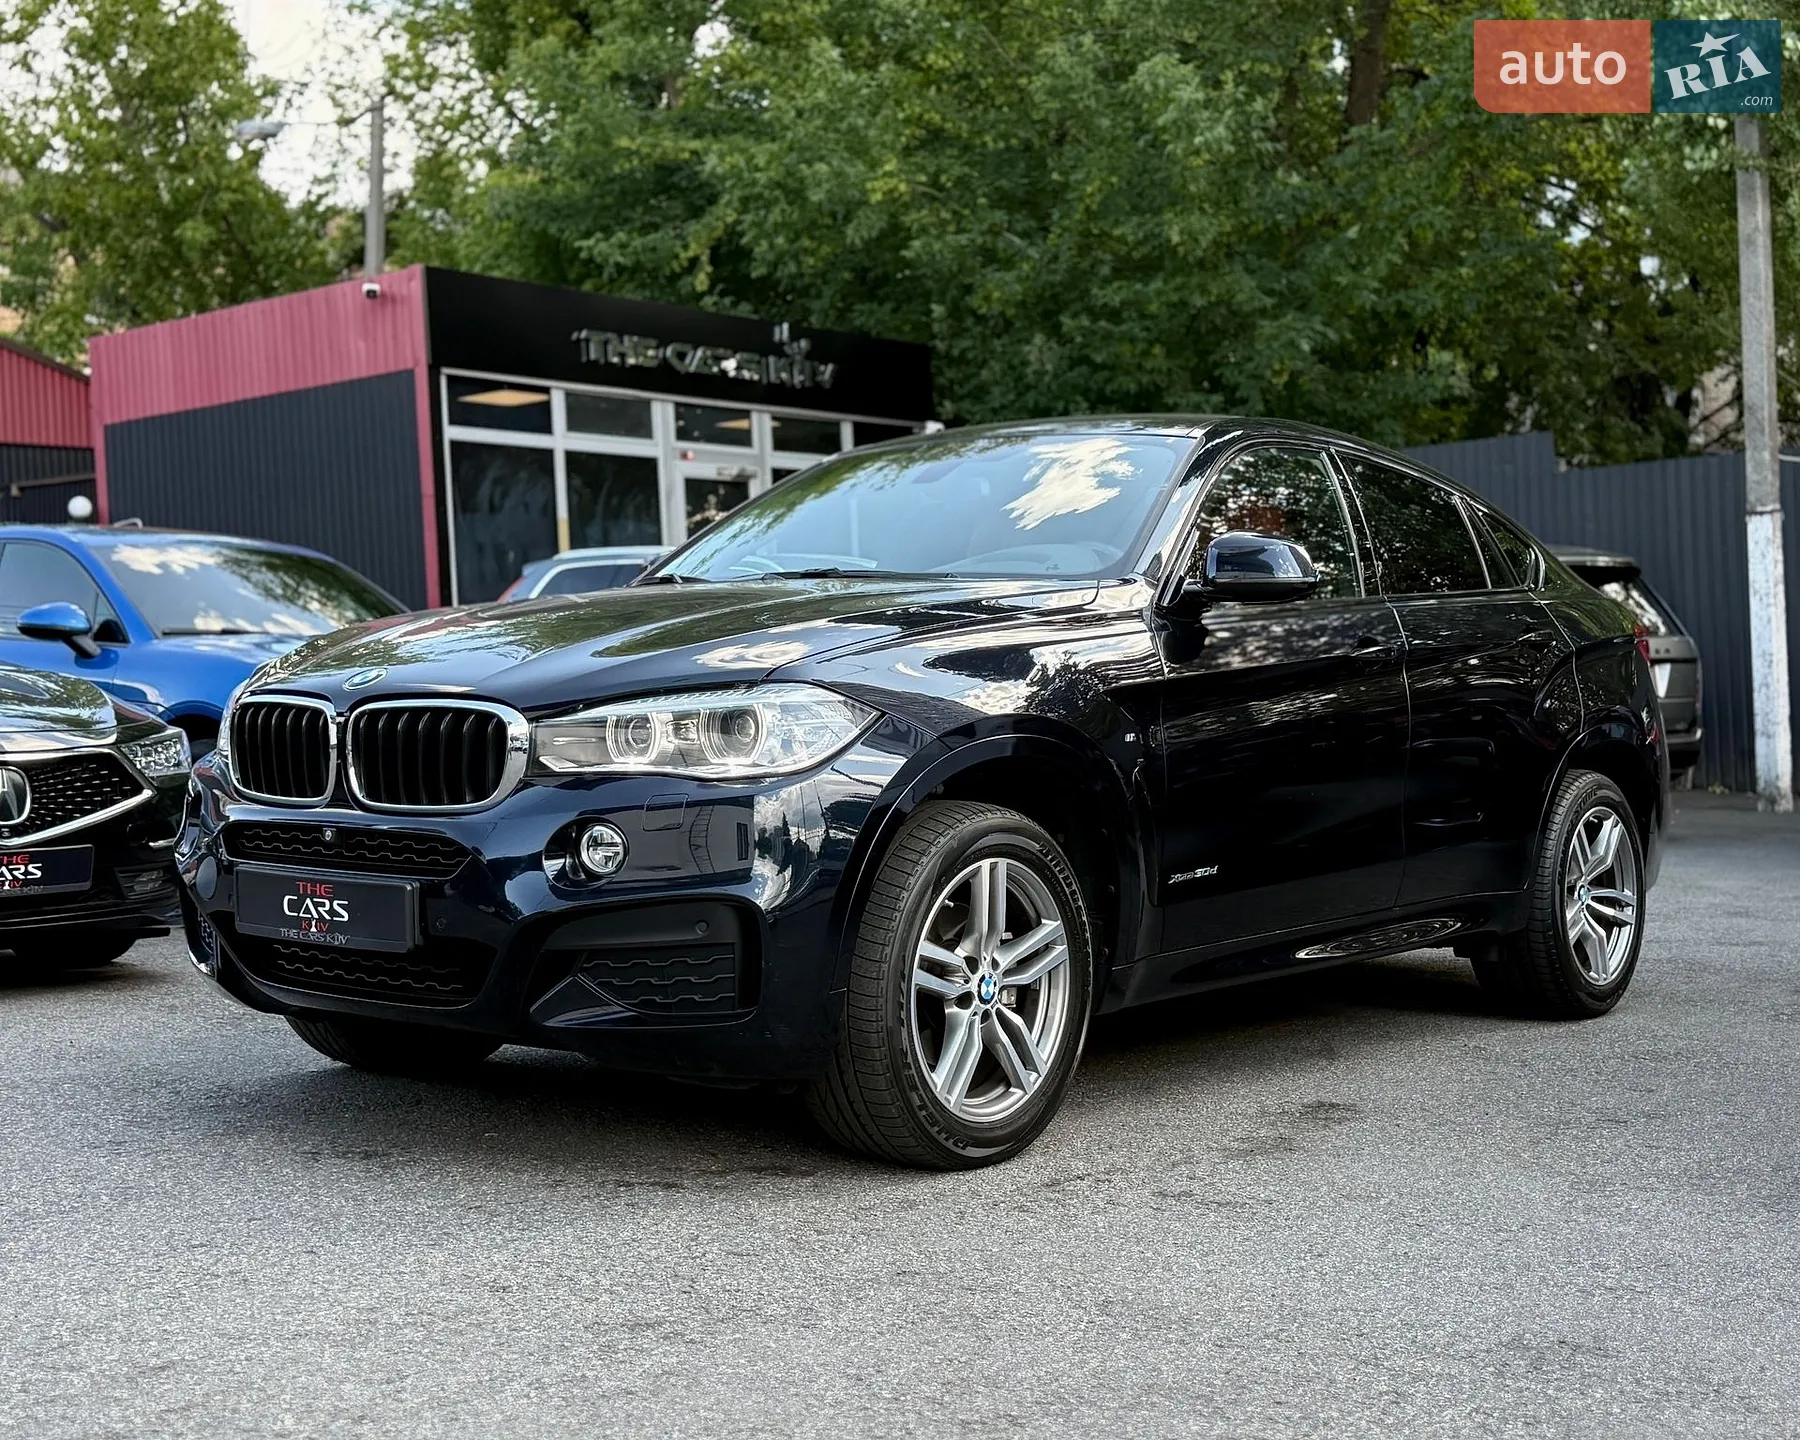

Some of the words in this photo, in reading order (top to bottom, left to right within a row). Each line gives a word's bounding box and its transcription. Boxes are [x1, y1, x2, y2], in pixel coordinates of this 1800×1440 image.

[571, 329, 661, 368] THE
[0, 854, 30, 864] HE
[0, 864, 42, 880] ARS
[296, 881, 334, 897] THE
[283, 895, 349, 922] CARS
[280, 928, 299, 939] THE
[299, 930, 325, 942] CARS
